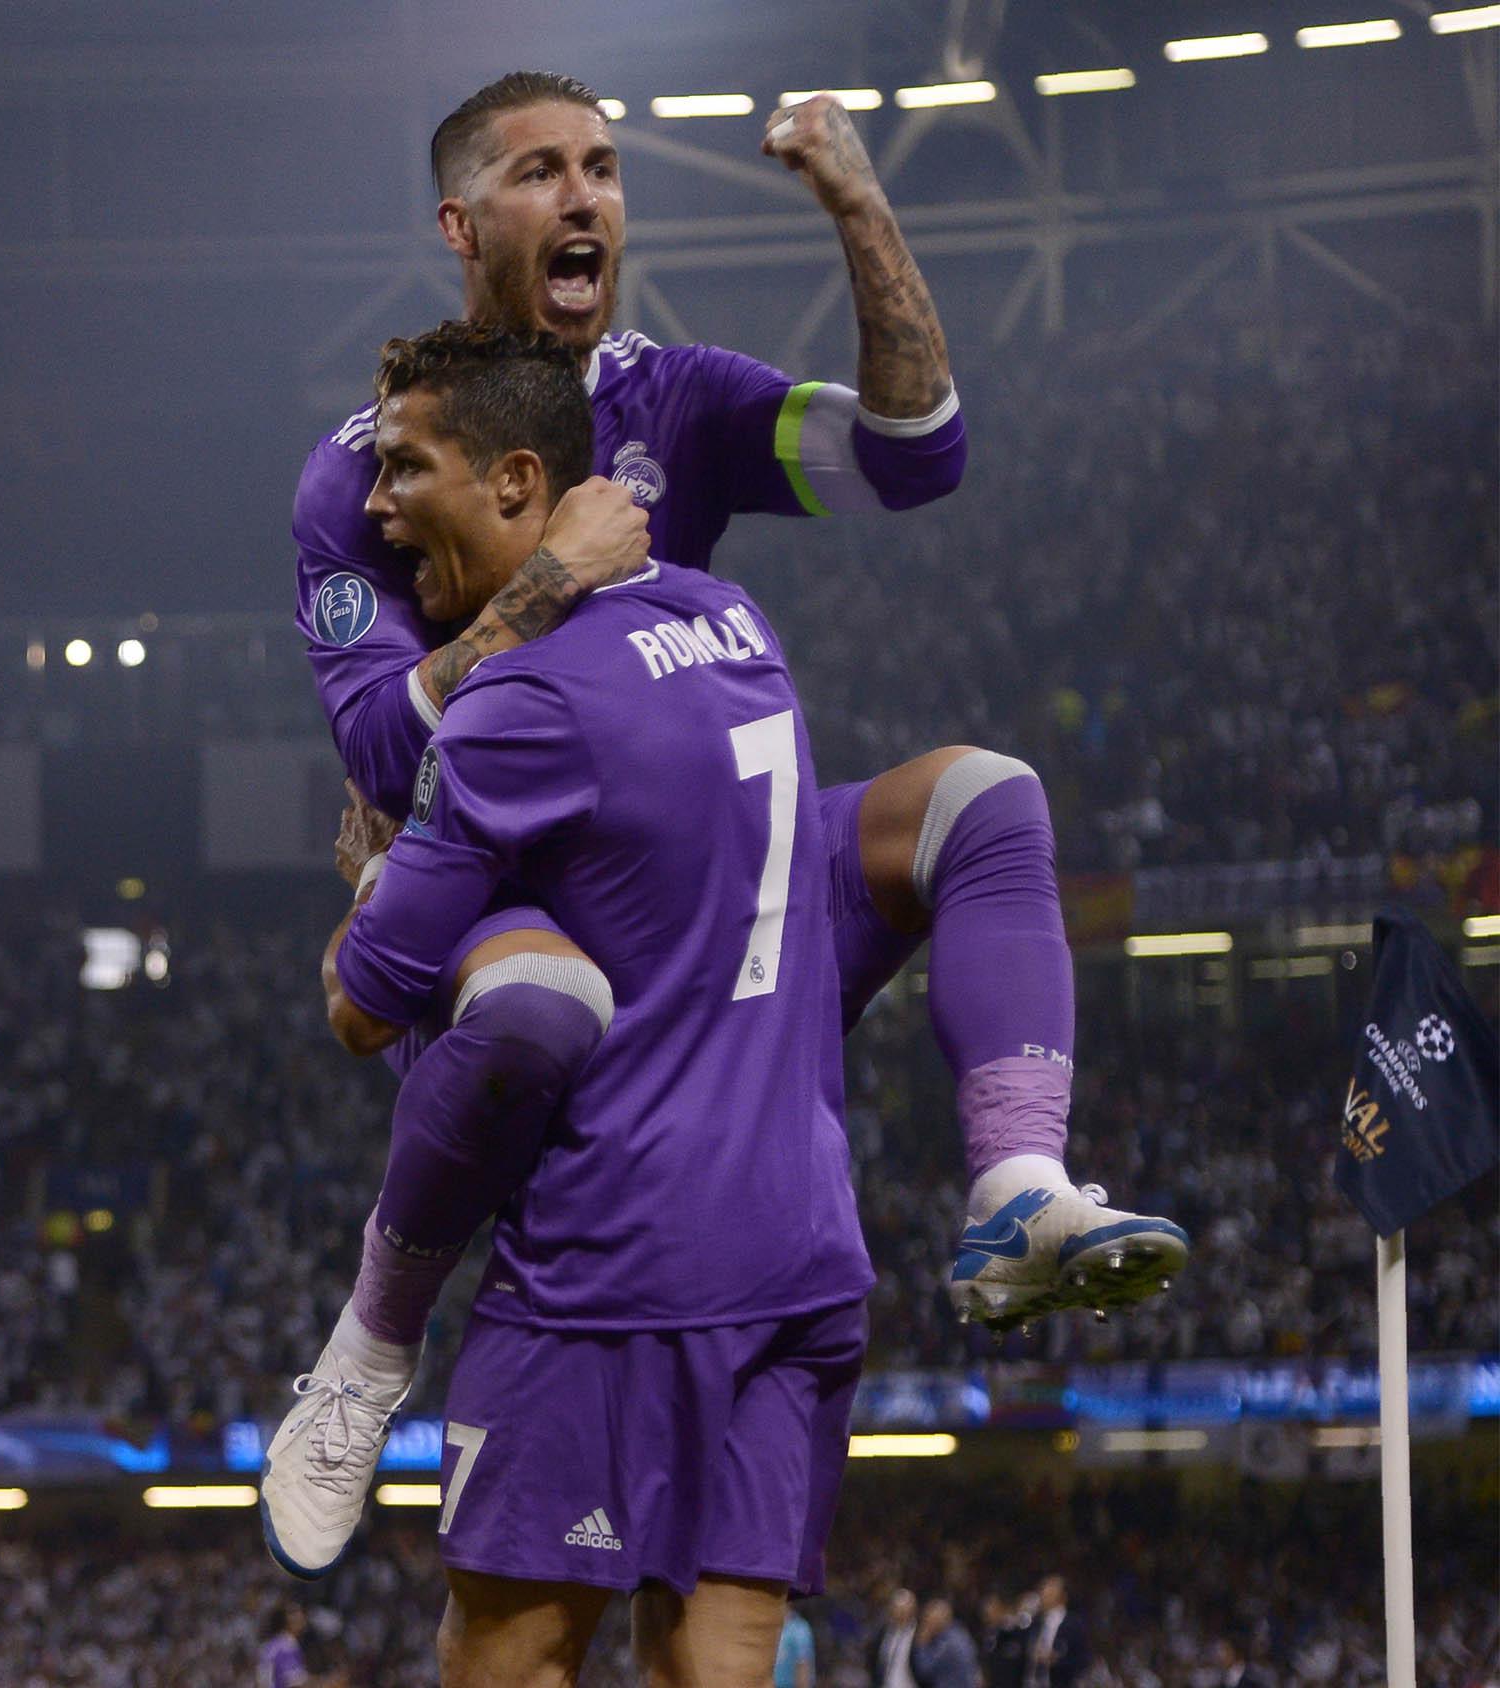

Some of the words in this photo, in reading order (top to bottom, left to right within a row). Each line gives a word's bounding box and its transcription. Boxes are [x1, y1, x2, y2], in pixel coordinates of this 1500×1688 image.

[332, 606, 351, 619] 2016
[729, 709, 799, 1001] 7
[1366, 1022, 1428, 1111] CHAMPIONS
[438, 1421, 488, 1534] 7
[565, 1530, 622, 1550] adidas
